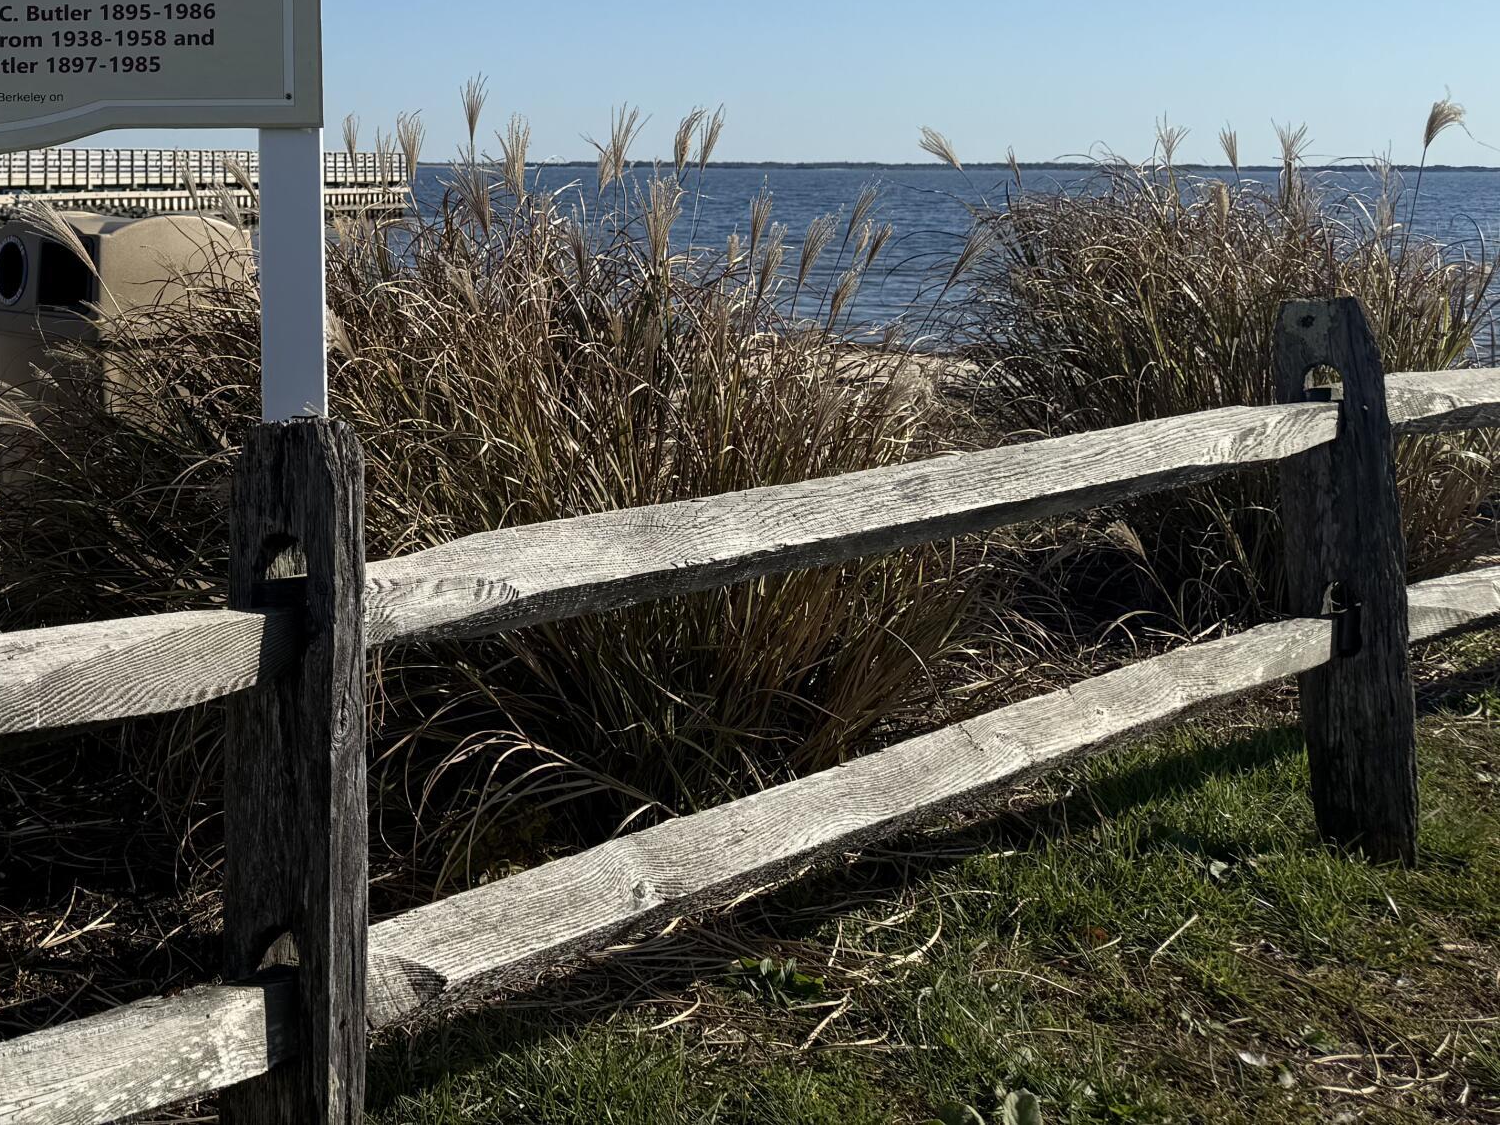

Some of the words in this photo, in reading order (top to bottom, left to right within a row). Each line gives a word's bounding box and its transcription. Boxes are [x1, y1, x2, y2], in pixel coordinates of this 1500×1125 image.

[0, 5, 19, 22] C.
[26, 4, 93, 22] Butler
[99, 3, 216, 20] 1895-1986
[51, 30, 167, 47] 1938-1958
[173, 28, 215, 46] and
[46, 56, 161, 74] 1897-1985
[49, 93, 64, 102] on
